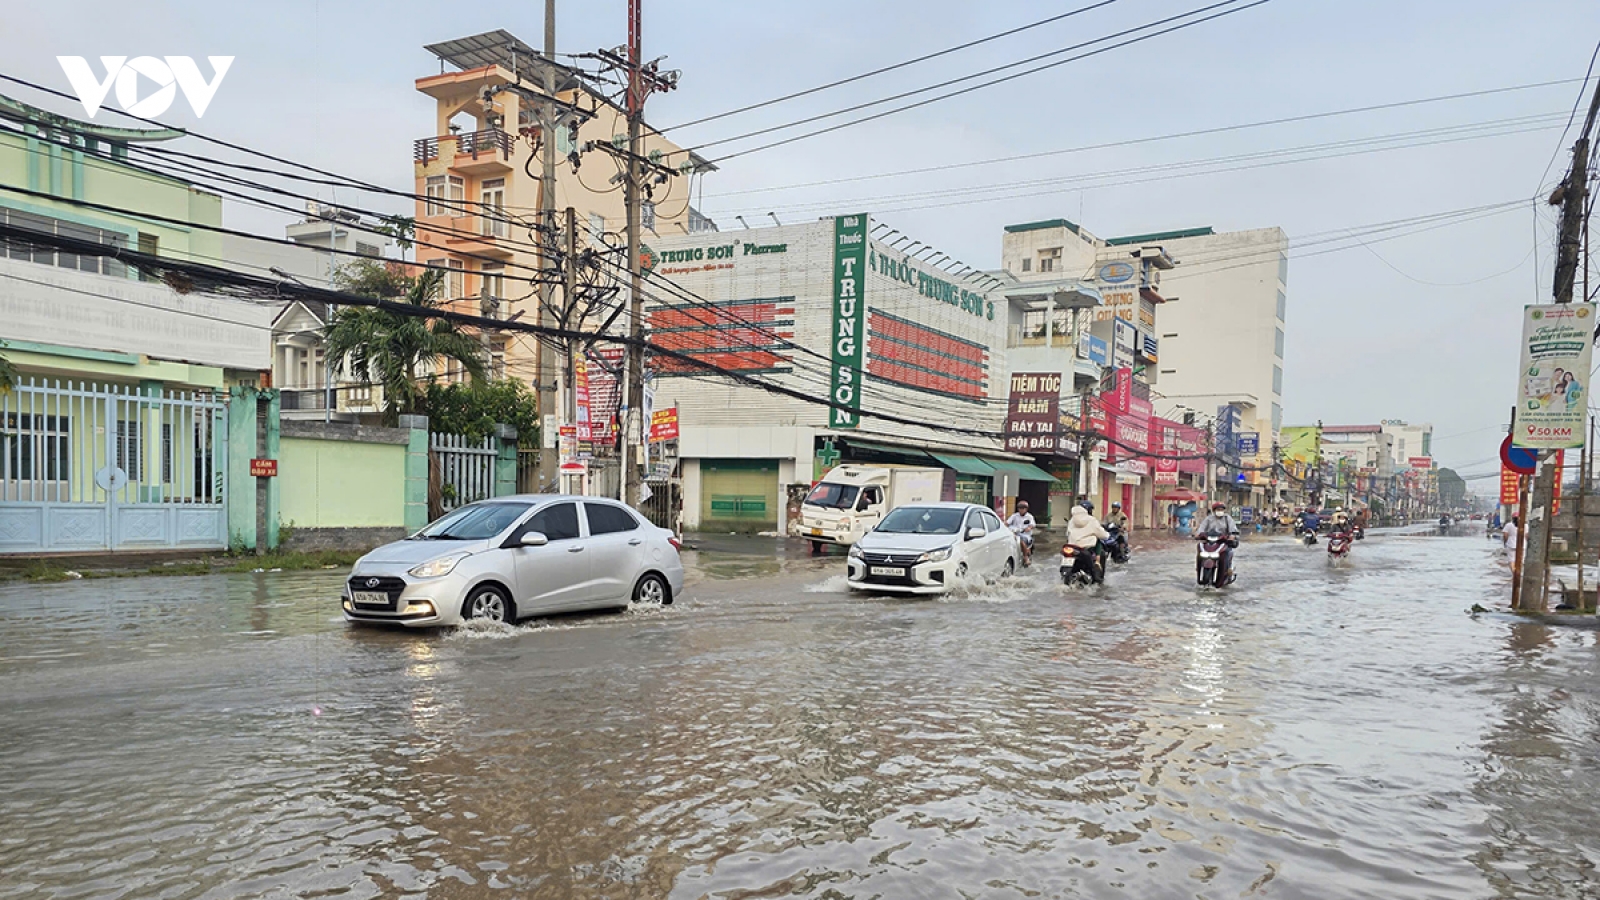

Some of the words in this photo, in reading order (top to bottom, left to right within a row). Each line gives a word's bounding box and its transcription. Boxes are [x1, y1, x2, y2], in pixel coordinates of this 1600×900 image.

[843, 215, 859, 228] Nhà
[839, 231, 862, 245] Thuốc
[660, 248, 704, 264] TRUNG
[743, 243, 787, 256] Pharma
[879, 254, 917, 287] THUỐC
[917, 271, 960, 307] TRUNG
[986, 301, 994, 321] 3
[837, 257, 856, 356] TRUNG
[1011, 373, 1037, 396] TIỆM
[1040, 373, 1060, 393] TÓC
[1011, 420, 1034, 432] RÁY
[1036, 422, 1053, 433] TAI
[1537, 427, 1551, 436] 50
[1553, 427, 1572, 436] KM
[1008, 435, 1028, 450] GỘI
